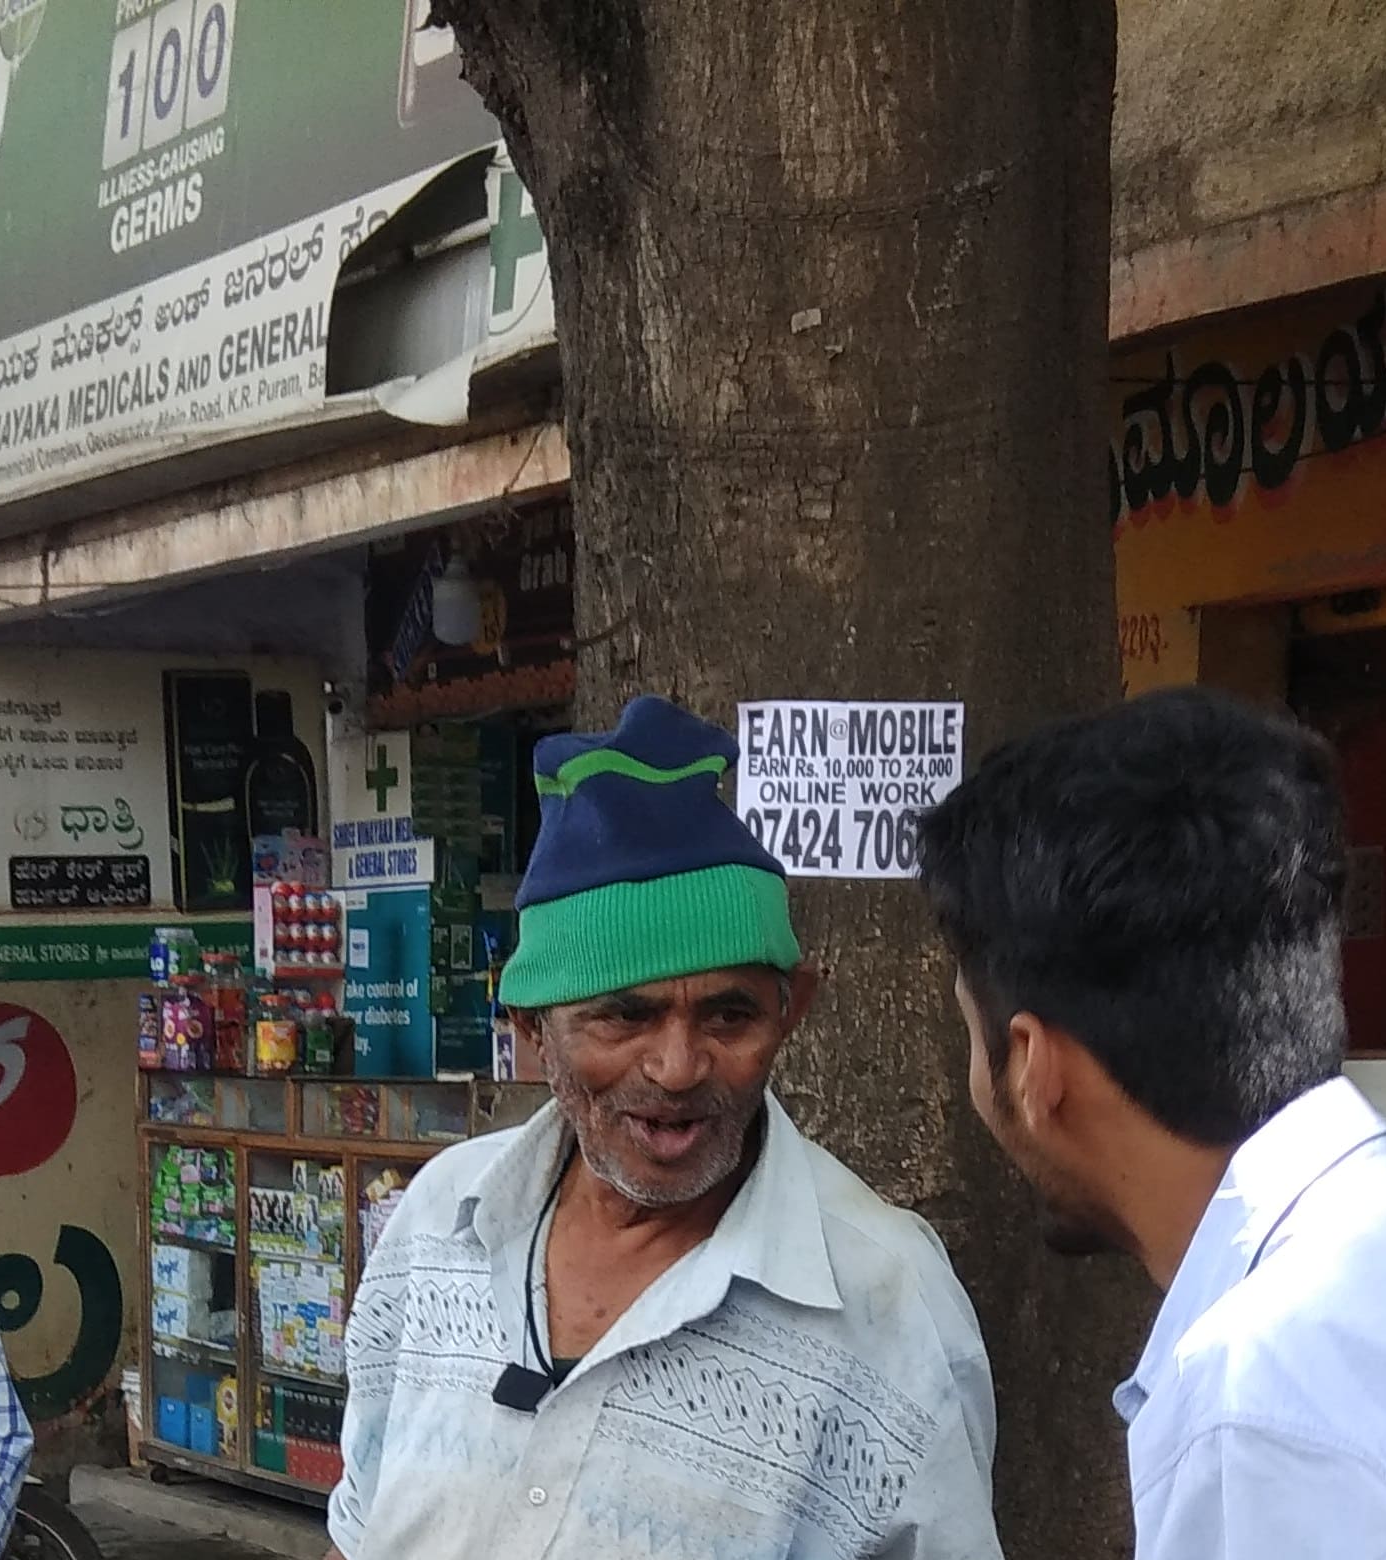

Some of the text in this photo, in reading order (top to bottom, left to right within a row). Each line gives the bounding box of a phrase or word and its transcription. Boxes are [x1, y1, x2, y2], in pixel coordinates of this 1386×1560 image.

[118, 3, 226, 140] 100
[98, 126, 225, 208] ILLNESS-CAUSING
[111, 172, 203, 253] GERMS
[223, 222, 325, 308] ಜನರಲ್
[66, 356, 170, 431] MEDICALS
[175, 353, 211, 396] AND
[218, 301, 327, 382] GENERAL
[748, 758, 953, 785] EARN Rs. 10,000 TO 24,000
[759, 781, 937, 806] ONLINE WORK
[853, 808, 917, 870] 706
[356, 850, 386, 879] GENERAL
[387, 847, 418, 876] STORES
[40, 943, 89, 963] STORES
[347, 977, 419, 999] ake control of
[364, 1004, 411, 1026] diabetes
